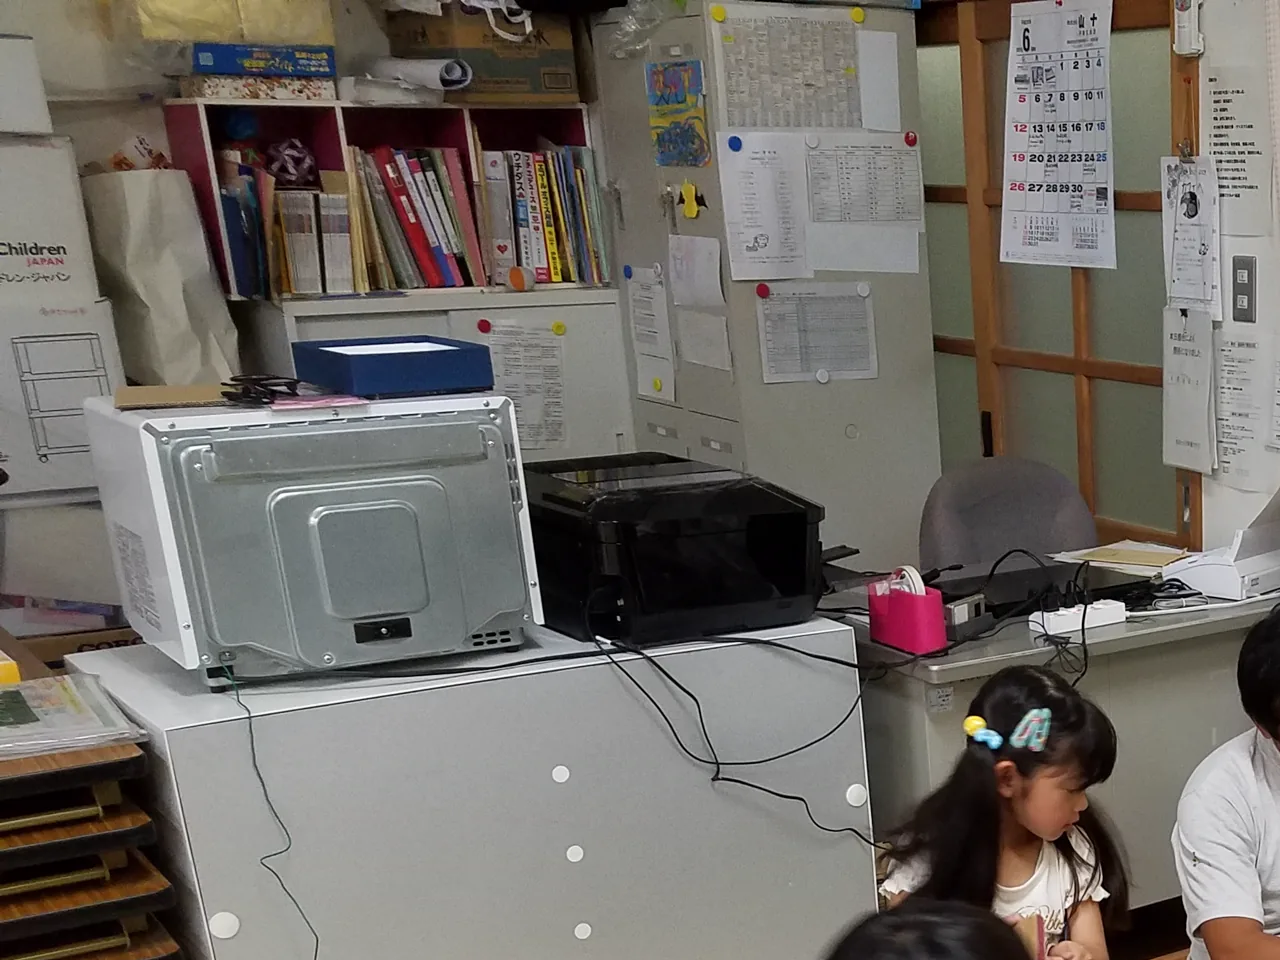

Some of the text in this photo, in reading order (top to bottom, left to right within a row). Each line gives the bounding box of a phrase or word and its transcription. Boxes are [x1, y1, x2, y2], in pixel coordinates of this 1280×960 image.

[1022, 27, 1030, 52] 6
[1060, 62, 1063, 70] 1
[1073, 61, 1078, 69] 2
[1086, 60, 1090, 68] 3
[1048, 94, 1052, 102] 7
[1060, 93, 1064, 101] 8
[1073, 92, 1079, 100] 9
[1085, 92, 1092, 100] 10
[1097, 91, 1103, 99] 11
[1014, 124, 1027, 132] 12
[1047, 124, 1055, 132] 14
[1059, 124, 1067, 132] 15
[1072, 123, 1081, 131] 16
[1085, 123, 1093, 131] 17
[1097, 122, 1105, 130] 18
[1029, 154, 1044, 162] 20
[1047, 154, 1055, 162] 21
[1059, 154, 1068, 162] 22
[1071, 154, 1082, 162] 23
[1010, 183, 1024, 191] 26
[1028, 184, 1043, 192] 27
[1046, 184, 1057, 192] 28
[26, 258, 65, 267] JAPAN
